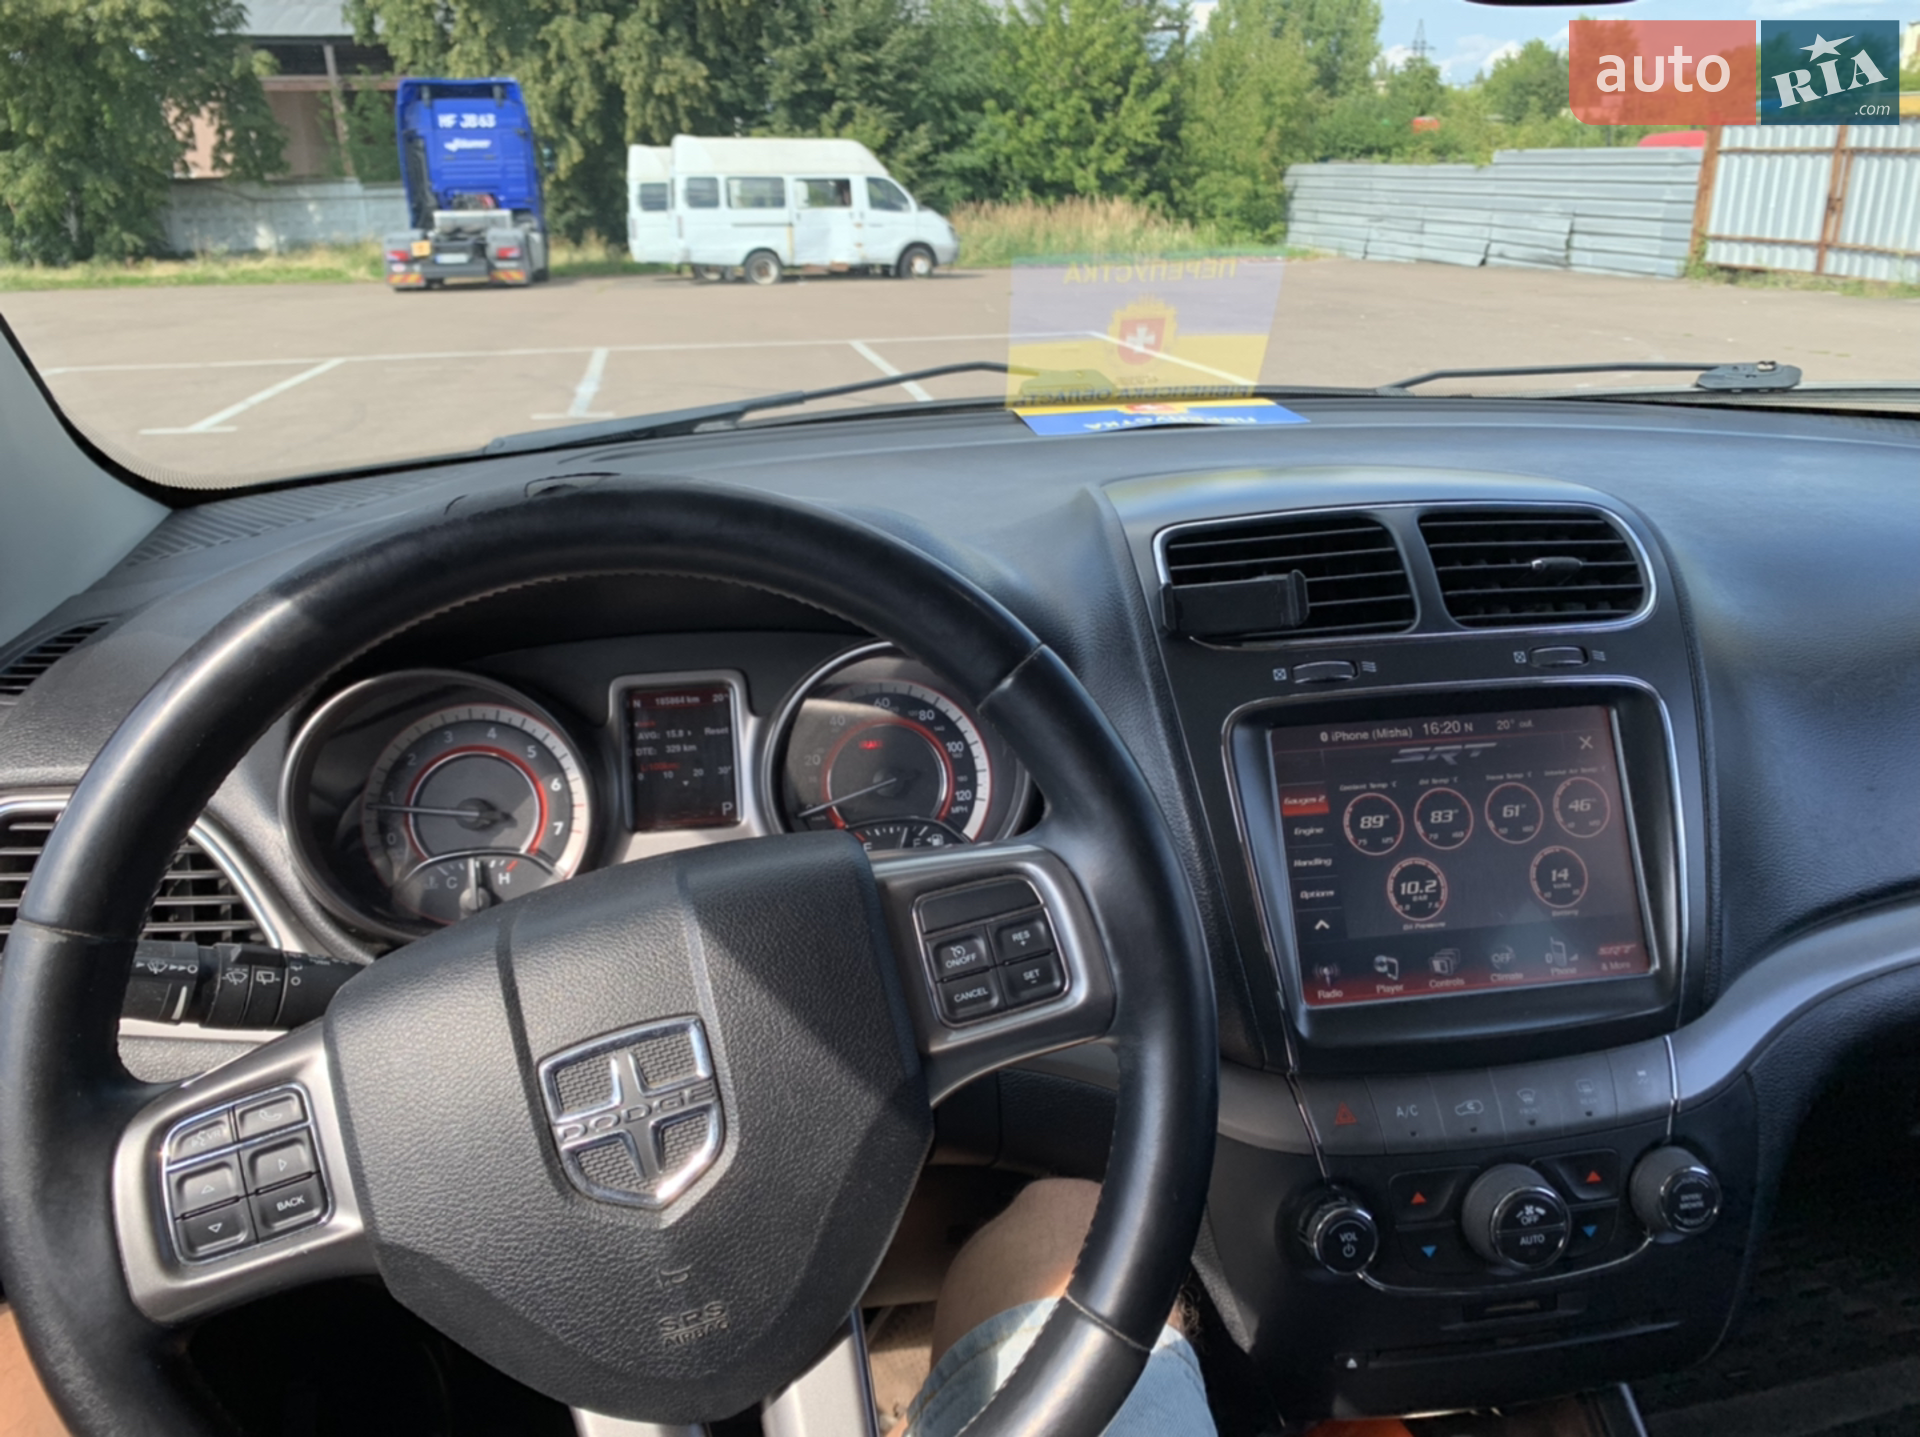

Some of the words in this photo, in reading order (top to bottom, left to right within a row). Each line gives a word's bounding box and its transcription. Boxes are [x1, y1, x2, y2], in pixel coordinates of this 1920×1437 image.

[918, 709, 936, 721] 80
[486, 727, 497, 740] 4
[1331, 732, 1369, 742] iPhone
[1372, 727, 1413, 740] (Misha)
[1422, 720, 1461, 735] 16:20
[1464, 722, 1474, 732] N
[443, 730, 454, 743] 3
[527, 745, 537, 759] 5
[946, 741, 965, 753] 100
[407, 753, 418, 767] 2
[550, 777, 562, 792] 6
[955, 789, 972, 801] 120
[721, 801, 734, 817] P
[552, 821, 564, 836] 7
[1293, 826, 1326, 837] Engine
[1293, 858, 1333, 868] Handling
[498, 872, 511, 886] H
[1551, 868, 1570, 882] 14
[446, 876, 458, 889] C
[1400, 879, 1438, 896] 10.2
[1299, 889, 1335, 900] Options
[1011, 929, 1031, 943] RES
[1023, 968, 1041, 982] SET
[1376, 983, 1403, 994] Player
[1429, 978, 1465, 988] Controls
[954, 987, 989, 1003] CANCEL
[1317, 989, 1343, 1000] Radio
[557, 1080, 716, 1142] DODGE
[1395, 1105, 1420, 1118] A/C
[276, 1195, 305, 1211] BACK
[1521, 1214, 1539, 1226] OFF
[1339, 1231, 1358, 1243] VOL
[1519, 1233, 1545, 1246] AUTO
[659, 1300, 727, 1334] SRS
[662, 1318, 730, 1350] AIRBAG
